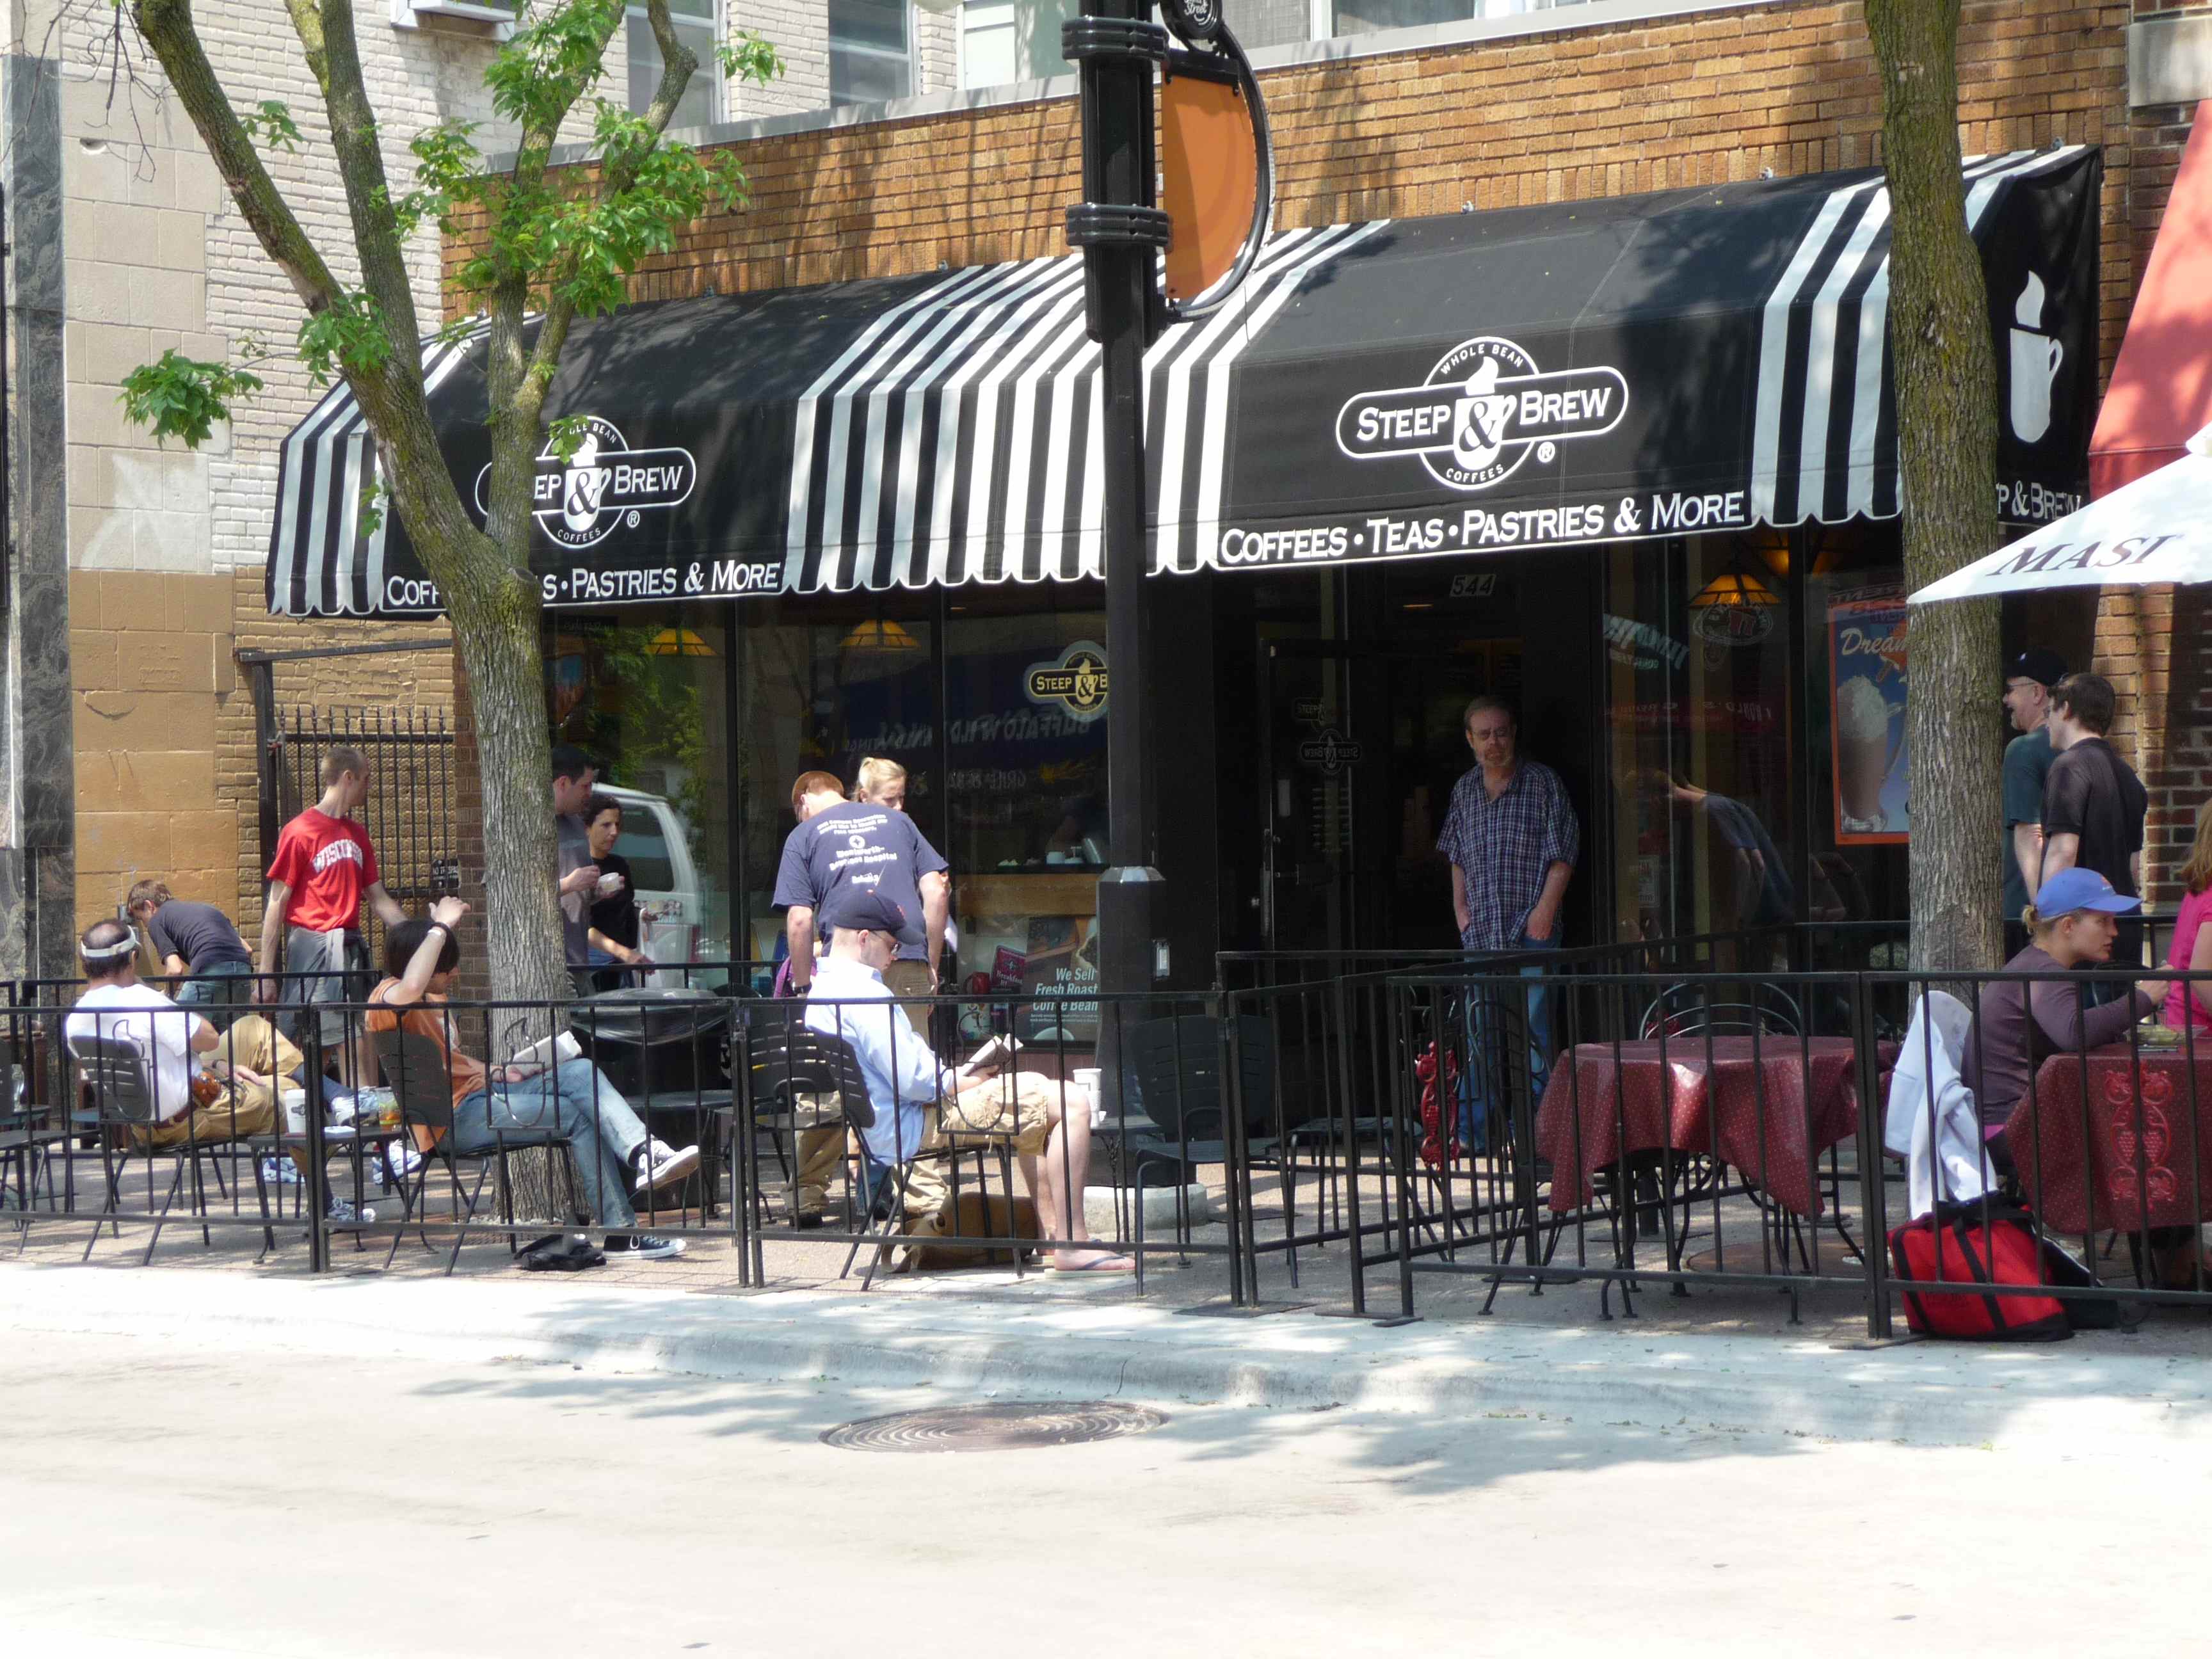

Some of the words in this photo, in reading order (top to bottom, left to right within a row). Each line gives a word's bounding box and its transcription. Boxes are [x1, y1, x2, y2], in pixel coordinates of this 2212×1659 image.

[1441, 344, 1485, 374] WHOLE
[1491, 344, 1524, 367] BEAN
[1357, 406, 1451, 442] STEEP
[1519, 387, 1612, 425] BREW
[593, 422, 617, 444] BEAN
[614, 465, 684, 494] BREW
[1446, 463, 1504, 483] COFFEES
[2012, 480, 2030, 516] &
[557, 527, 601, 542] COFFEES
[1221, 528, 1347, 563] COFFEES
[1614, 497, 1641, 533] &
[1651, 490, 1744, 530] MORE
[1985, 534, 2184, 576] MASI
[572, 568, 677, 598] PASTRIES
[684, 562, 704, 593] &
[711, 559, 781, 591] MORE
[1453, 576, 1493, 595] 544
[1036, 676, 1072, 691] STEEP
[864, 853, 897, 863] Hospital
[1055, 968, 1072, 981] We
[1074, 967, 1095, 981] Sell
[1035, 982, 1064, 995] Fresh
[1033, 1002, 1068, 1011] Coffe
